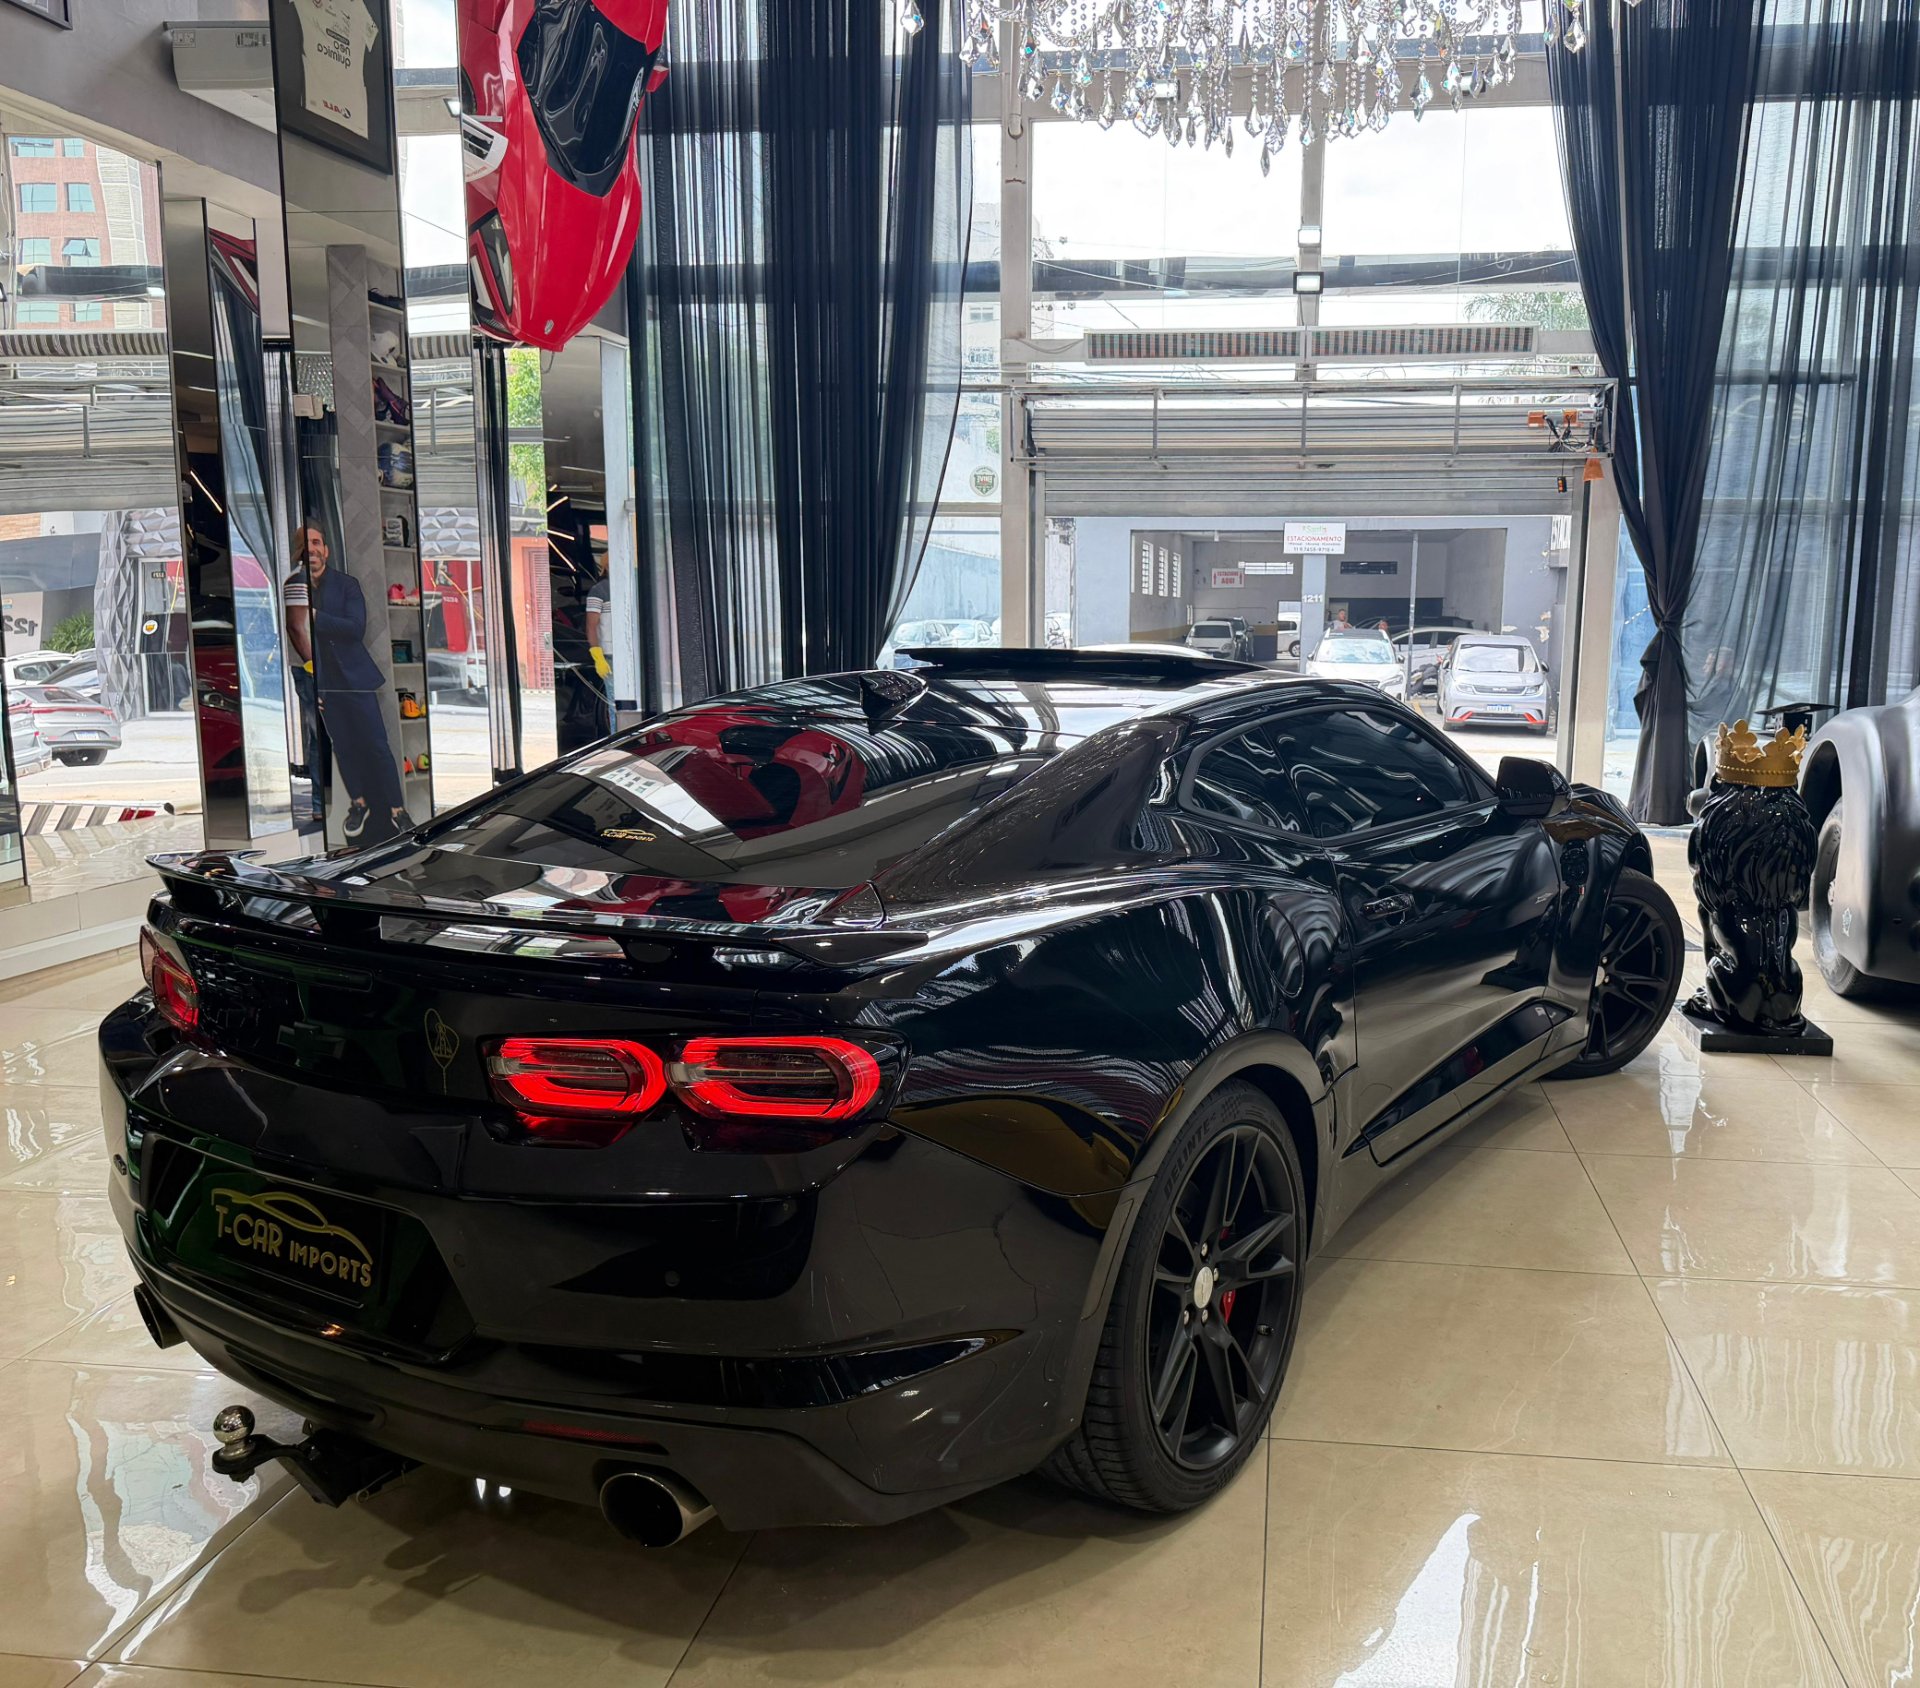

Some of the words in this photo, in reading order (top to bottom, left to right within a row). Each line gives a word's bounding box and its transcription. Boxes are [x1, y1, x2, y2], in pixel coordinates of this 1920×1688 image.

[1302, 594, 1324, 603] 1211
[215, 1204, 283, 1258] T-CAR
[289, 1240, 373, 1288] IMPORTS
